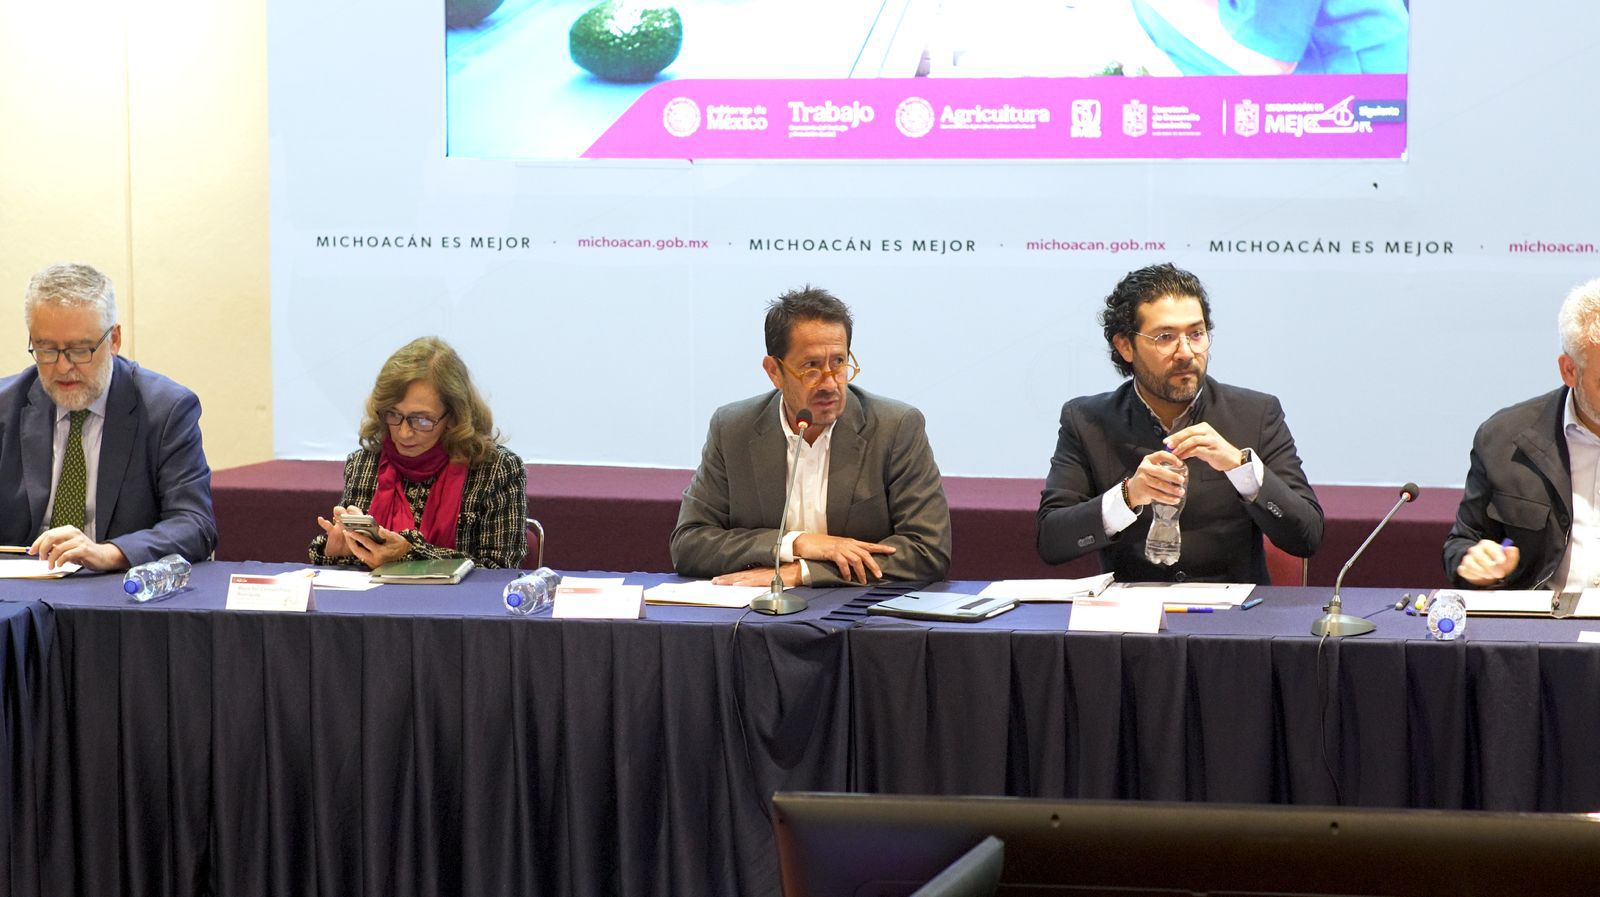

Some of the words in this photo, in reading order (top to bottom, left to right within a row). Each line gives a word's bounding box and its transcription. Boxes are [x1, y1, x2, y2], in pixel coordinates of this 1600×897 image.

[788, 100, 875, 128] Trabajo
[940, 104, 1051, 126] Agricultura
[316, 234, 432, 249] MICHOACÁN
[441, 236, 461, 249] ES
[470, 236, 530, 252] MEJOR
[578, 236, 709, 251] michoacan.gob.mx
[750, 236, 872, 252] MICHOACÁN
[881, 239, 902, 252] ES
[911, 239, 976, 255] MEJOR
[1026, 239, 1166, 254] michoacan.gob.mx
[1209, 237, 1341, 254] MICHOACÁN
[1351, 240, 1375, 254] ES
[1384, 240, 1454, 257] MEJOR
